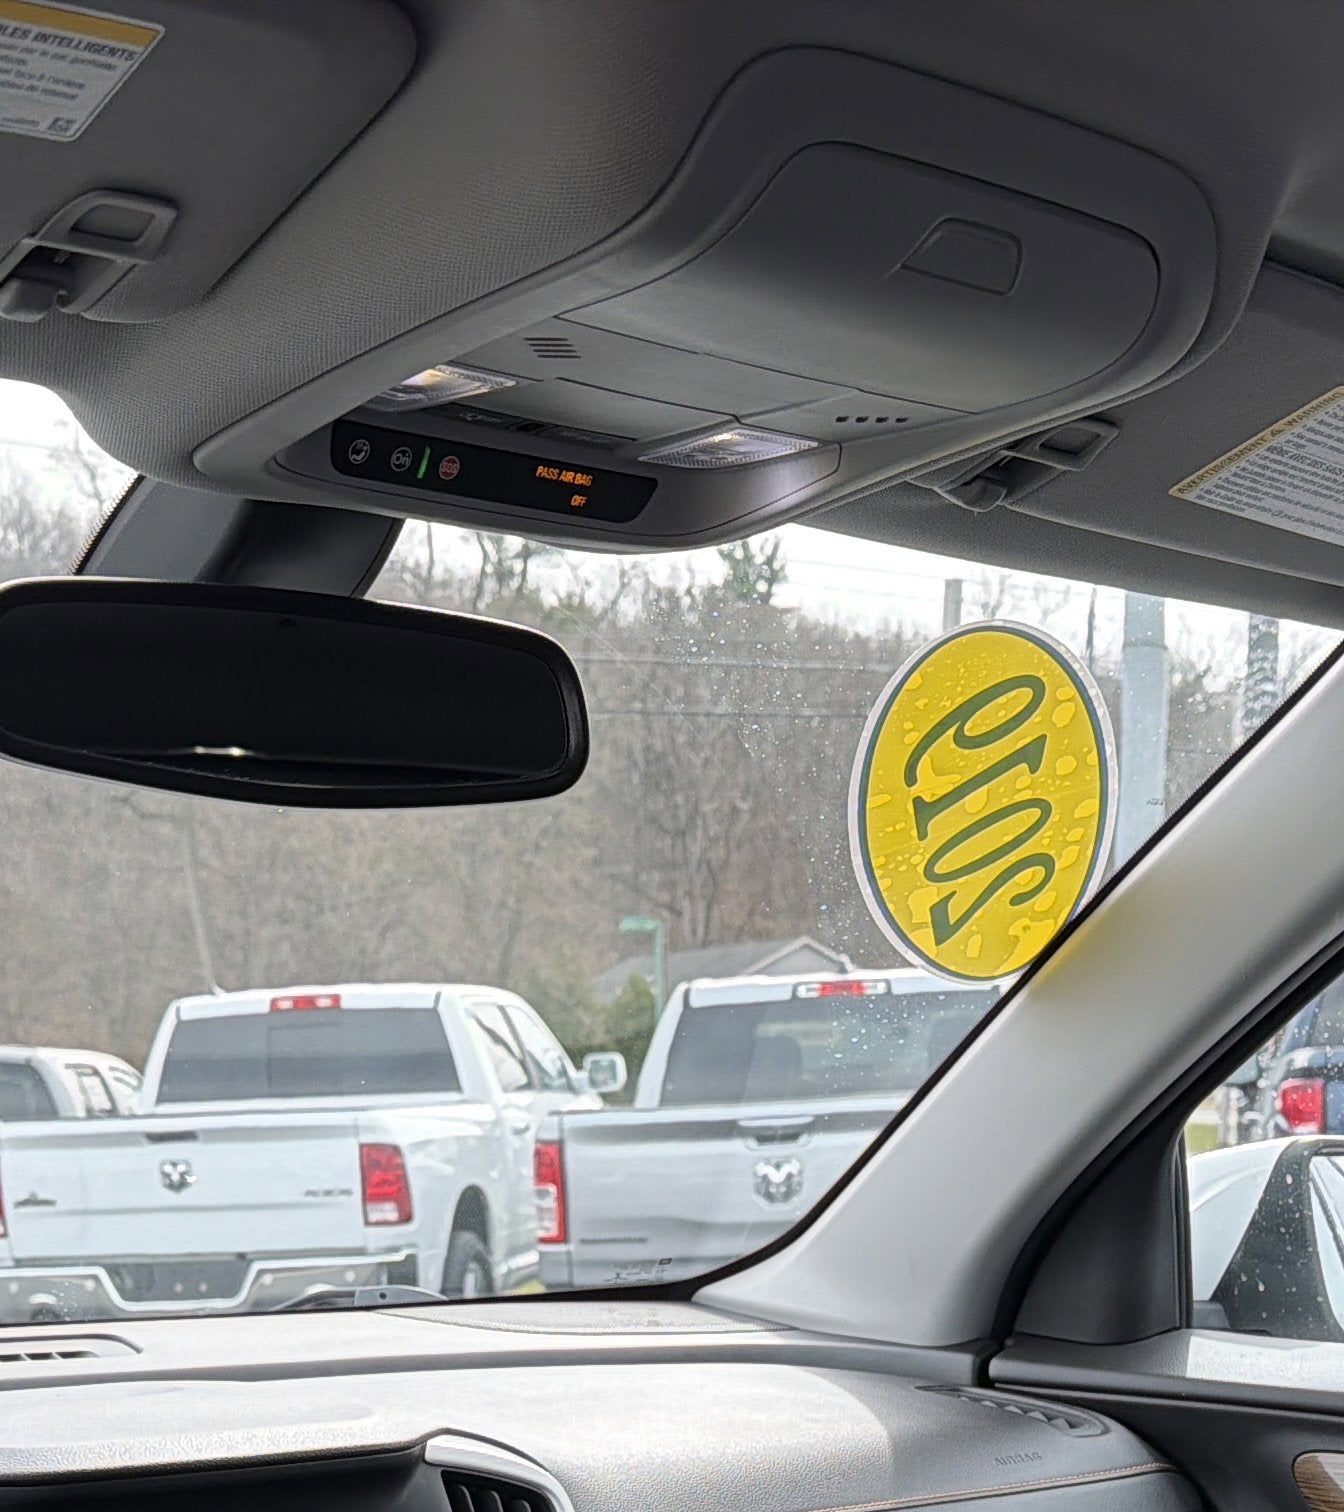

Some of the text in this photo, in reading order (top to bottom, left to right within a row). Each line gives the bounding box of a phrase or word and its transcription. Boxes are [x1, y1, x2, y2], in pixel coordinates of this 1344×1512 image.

[31, 32, 139, 62] INTELLIGENTS
[536, 466, 593, 487] PASS AIR BAG
[571, 494, 588, 507] OFF
